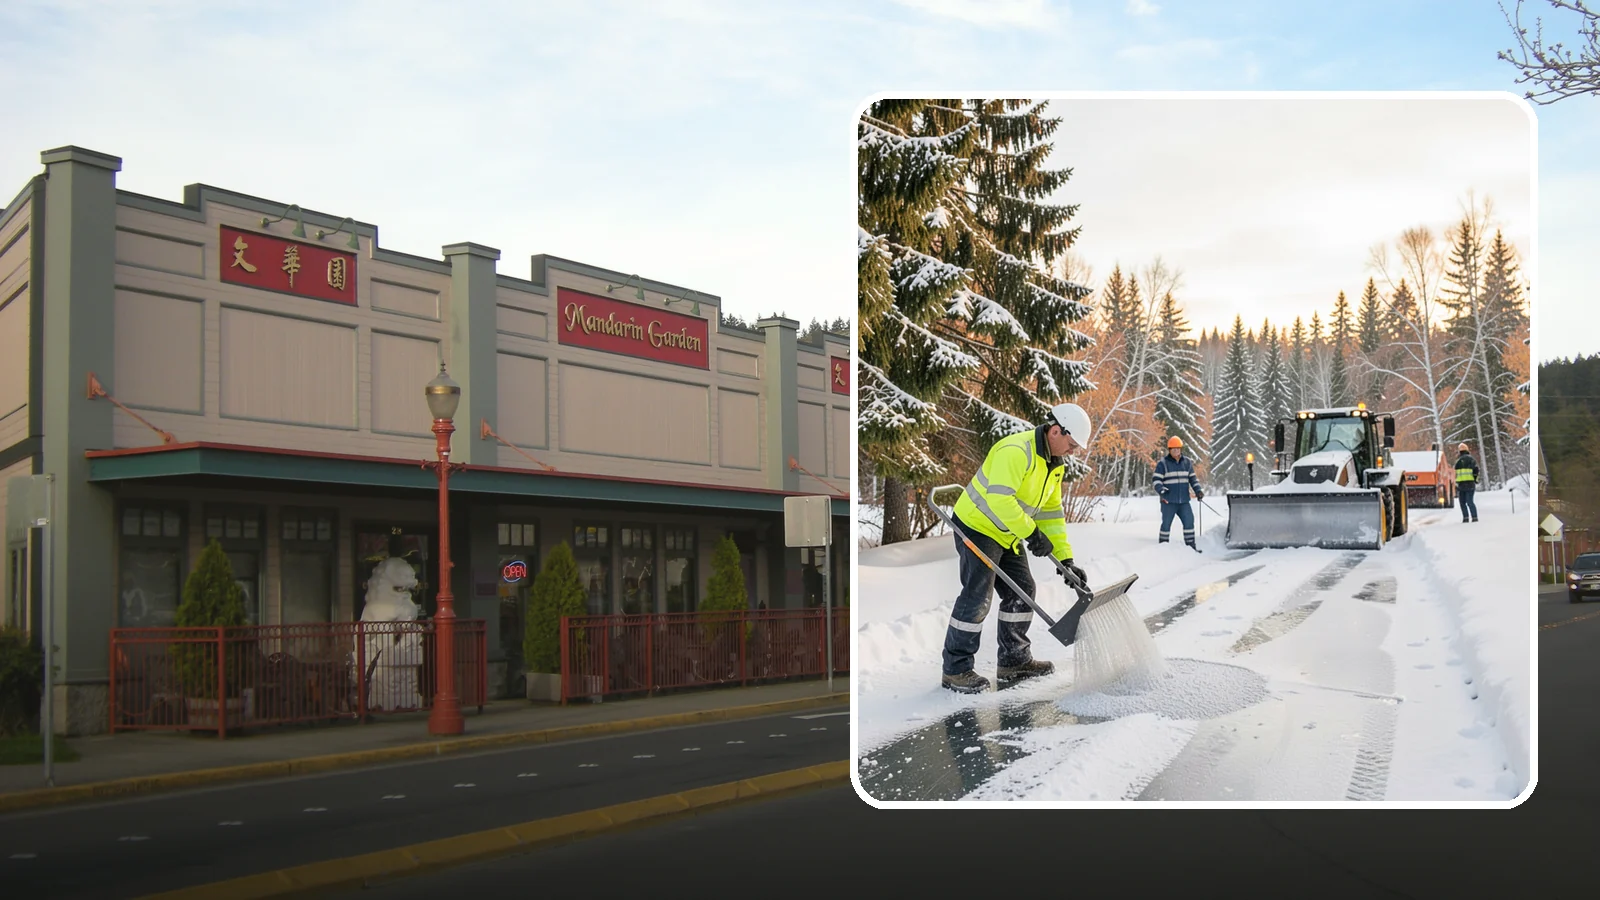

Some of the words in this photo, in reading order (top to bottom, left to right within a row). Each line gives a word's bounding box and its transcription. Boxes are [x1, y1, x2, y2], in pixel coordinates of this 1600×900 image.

[231, 235, 346, 291] 文華園
[564, 302, 644, 341] Mandarin
[648, 320, 701, 352] Garden
[503, 565, 527, 578] OPEN
